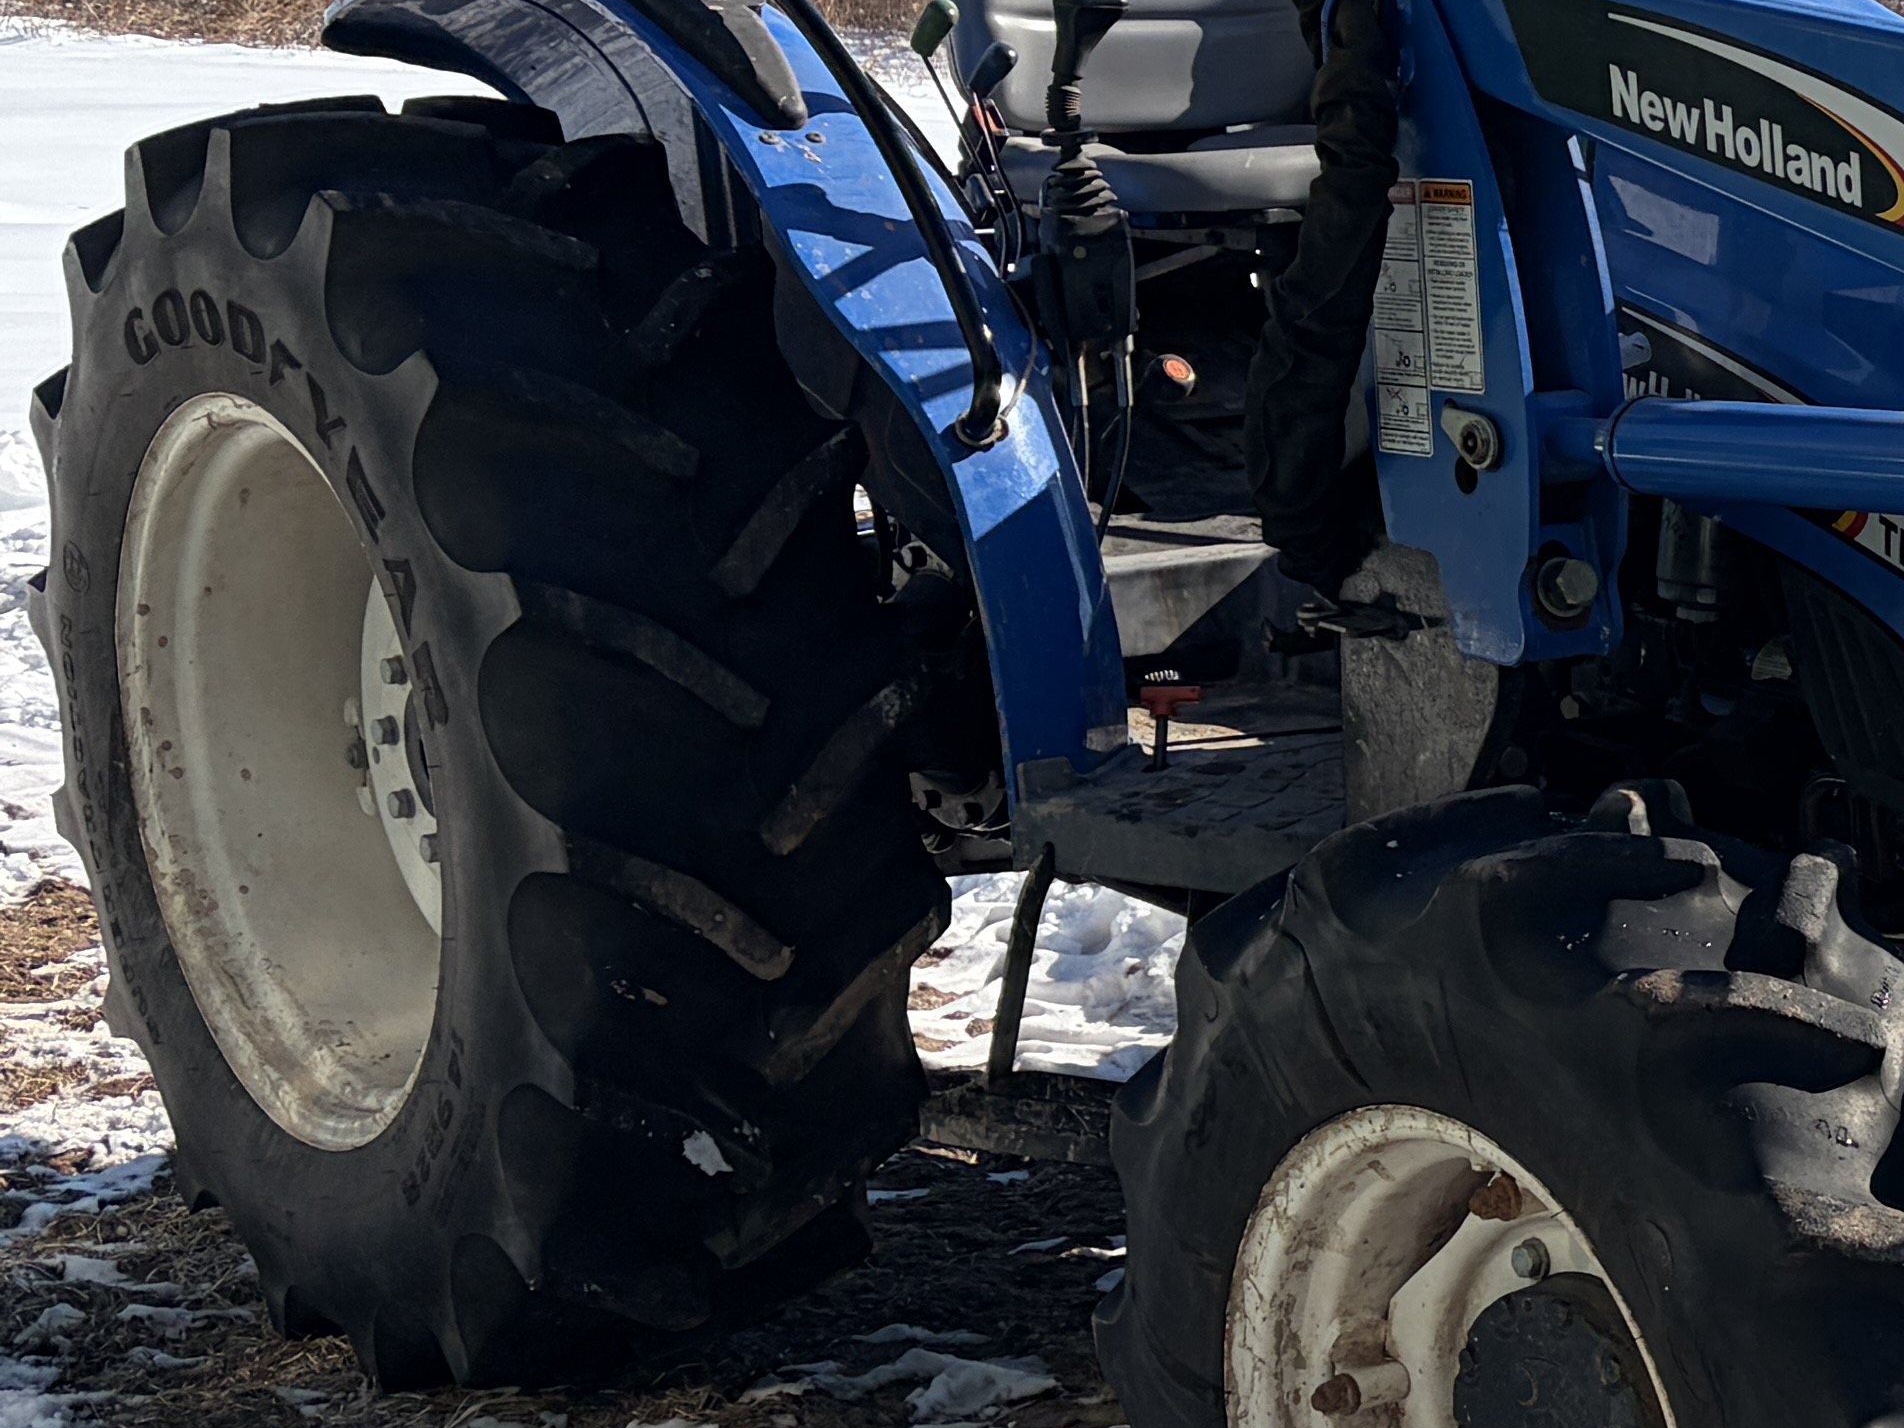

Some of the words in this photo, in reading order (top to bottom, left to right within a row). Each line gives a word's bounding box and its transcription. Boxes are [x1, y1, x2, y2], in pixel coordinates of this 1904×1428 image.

[1434, 189, 1466, 199] WARNING
[1608, 64, 1699, 145] New
[1704, 98, 1863, 208] Holland
[123, 286, 450, 732] GOODYEAR
